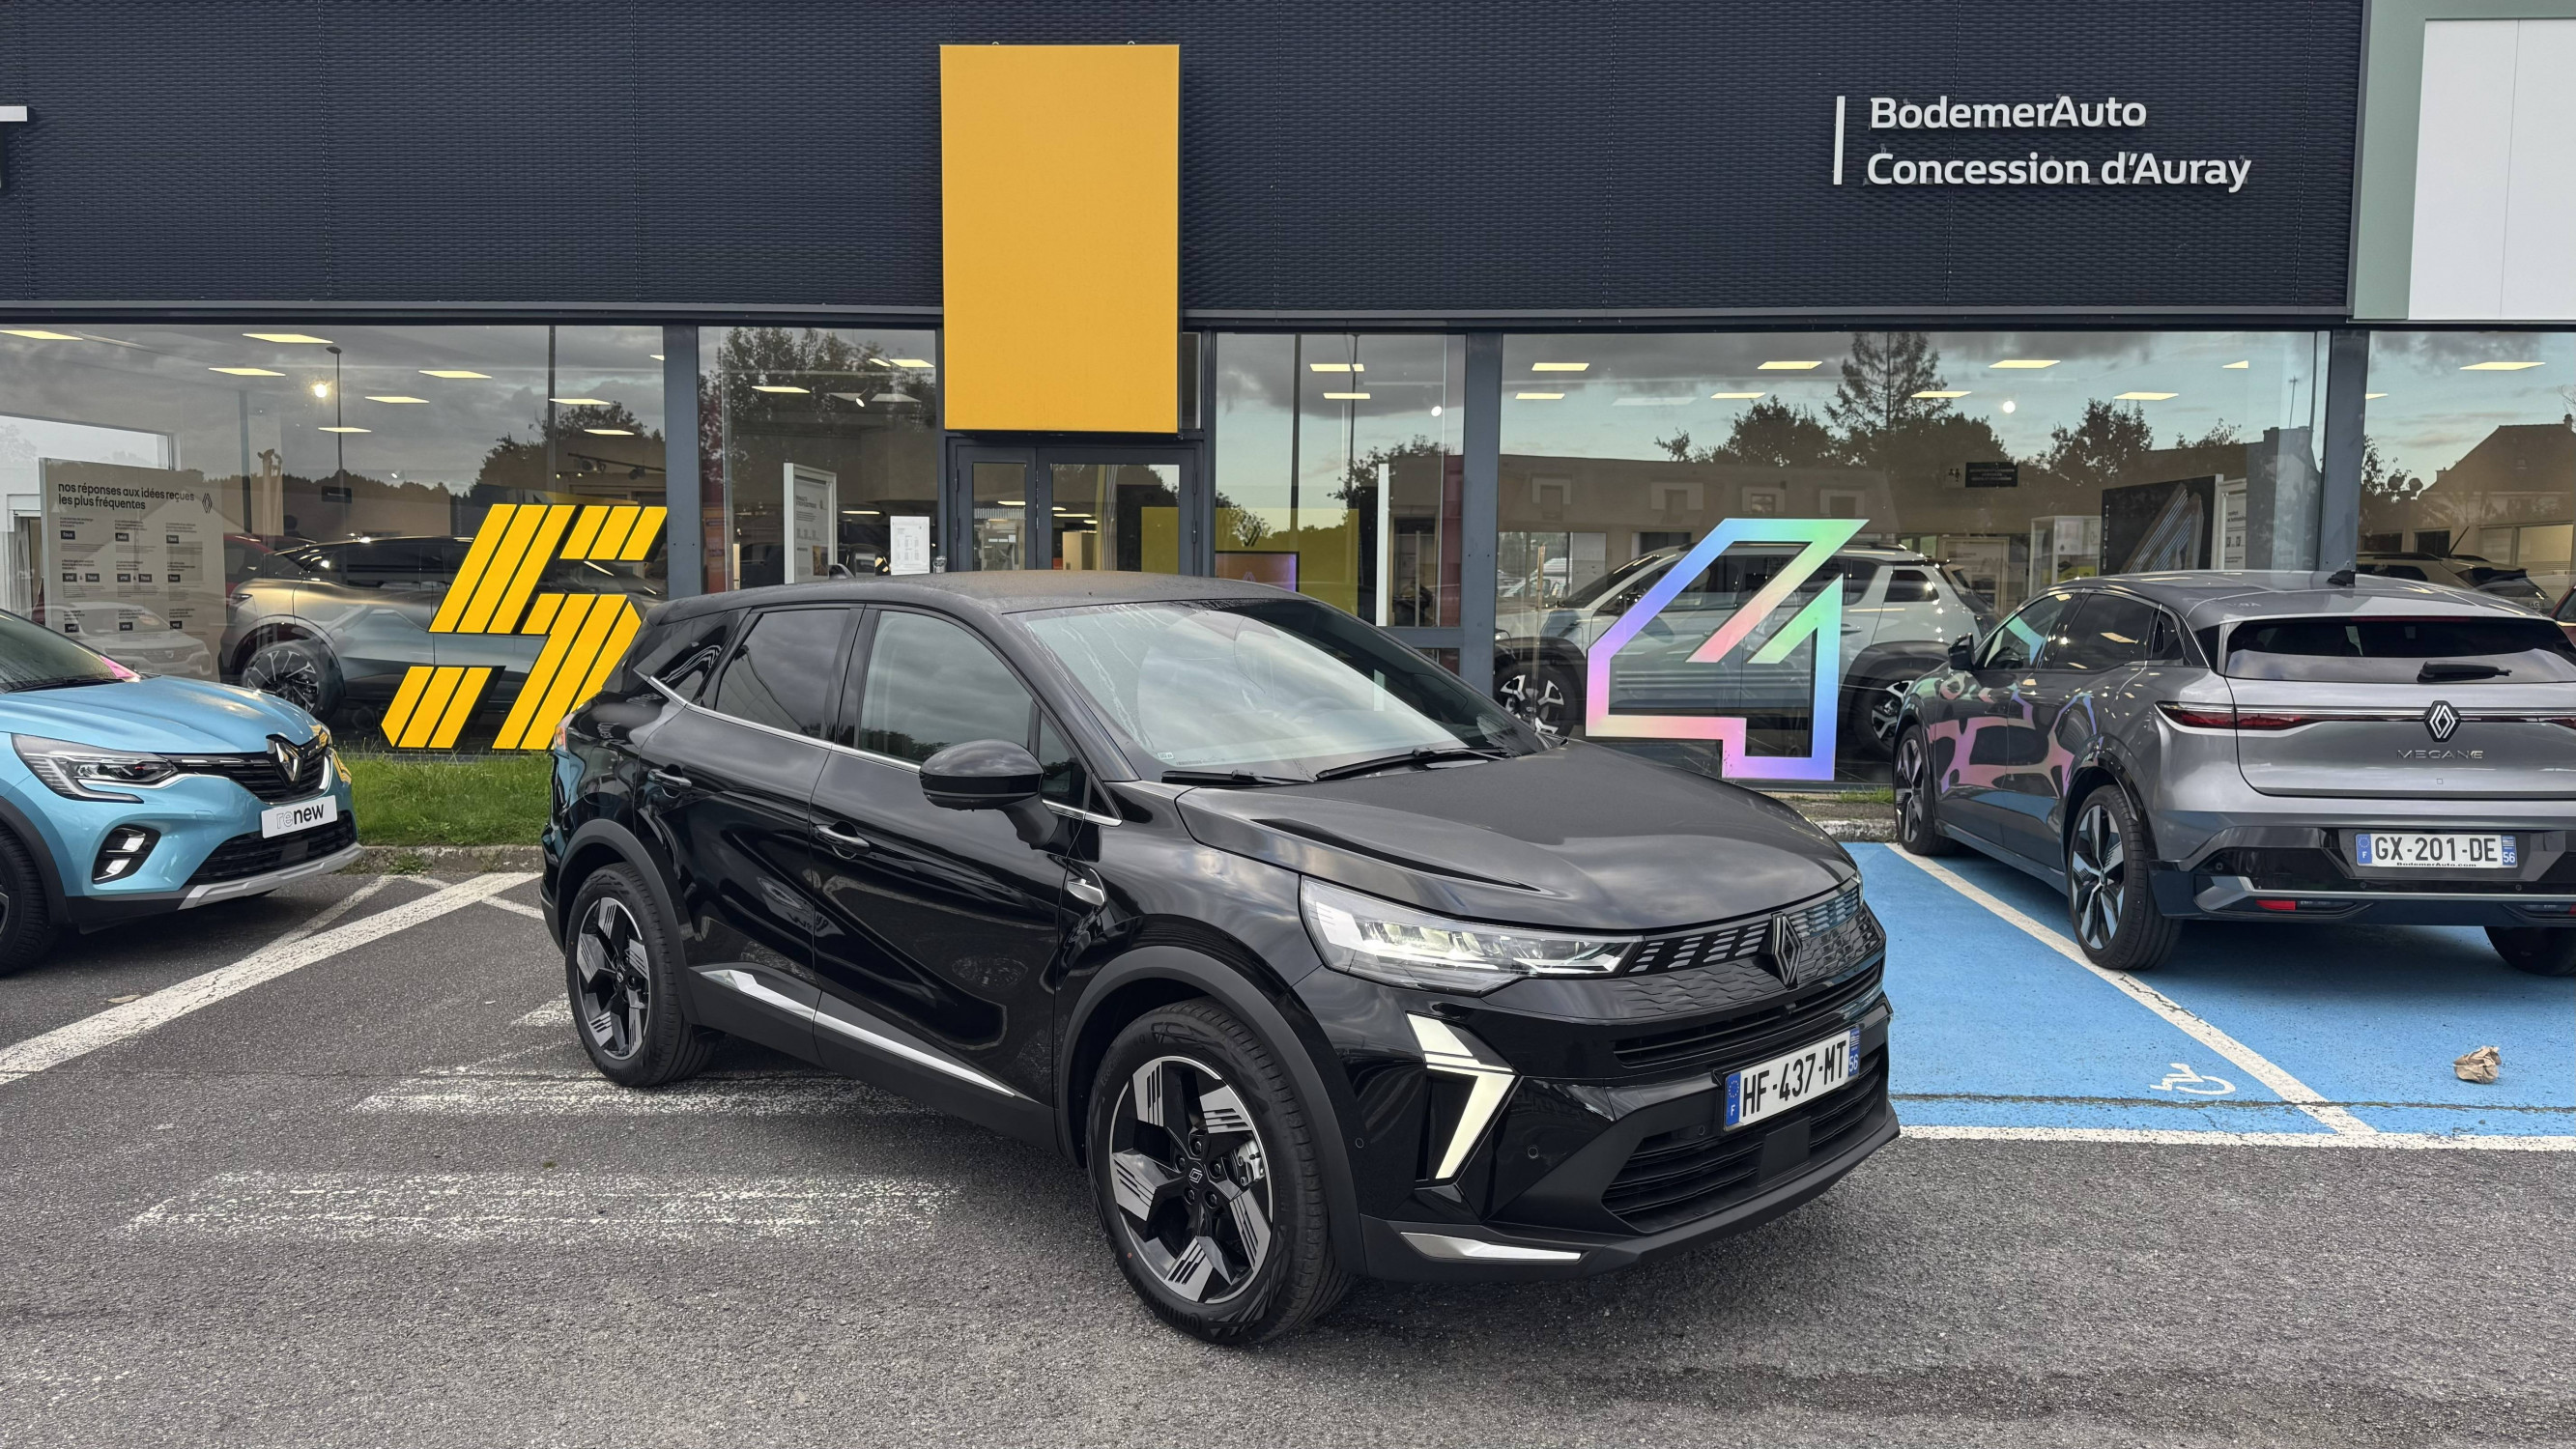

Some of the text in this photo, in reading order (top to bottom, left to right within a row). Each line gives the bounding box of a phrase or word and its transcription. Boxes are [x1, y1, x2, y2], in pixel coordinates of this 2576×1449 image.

[1871, 95, 2147, 128] BodemerAuto
[1868, 151, 2252, 193] Concession d'Auray
[58, 482, 195, 502] nos réponses aux idées reçues
[58, 493, 146, 510] les plus fréquentes
[2396, 750, 2484, 760] MEGANE
[276, 804, 325, 829] renew
[2375, 837, 2498, 862] GX-201-DE
[2503, 851, 2516, 864] 56
[1848, 1054, 1859, 1072] 56
[1742, 1039, 1846, 1118] HF-437-MT
[1731, 1104, 1736, 1116] F
